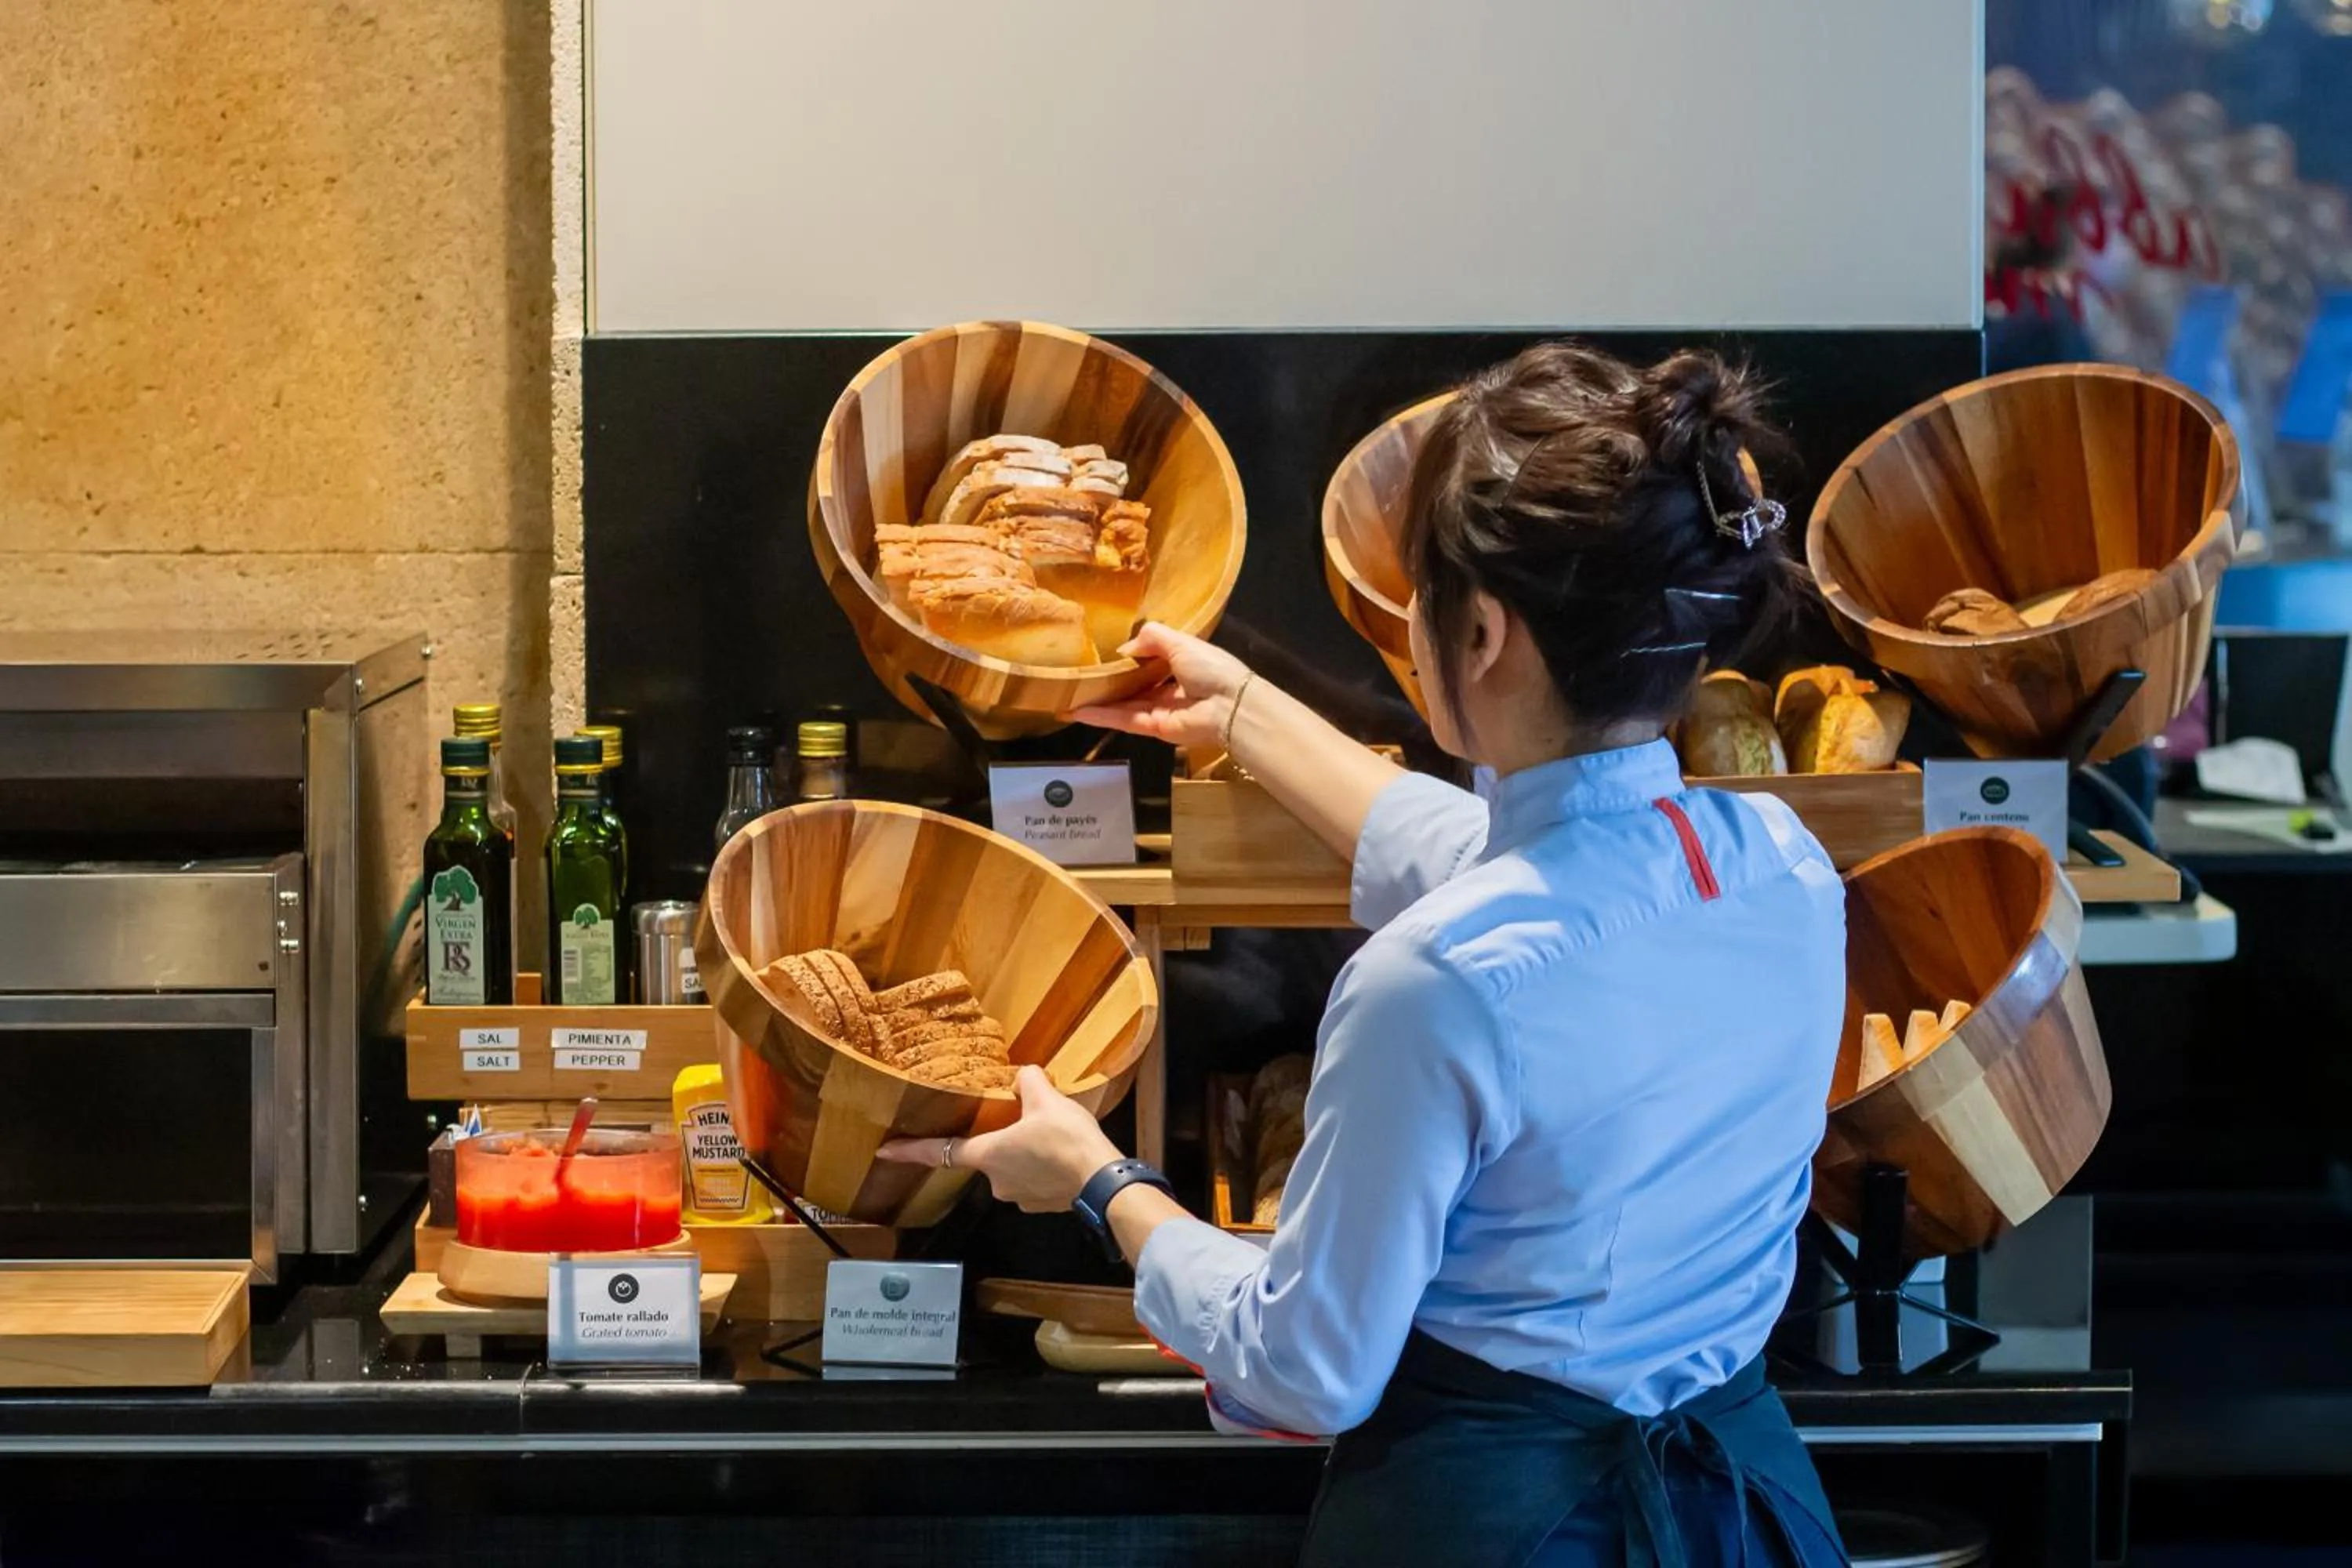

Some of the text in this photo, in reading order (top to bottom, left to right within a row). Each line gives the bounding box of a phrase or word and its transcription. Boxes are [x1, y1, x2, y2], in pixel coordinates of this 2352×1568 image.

[1024, 815, 1046, 826] Pan
[1048, 814, 1062, 826] de
[477, 1033, 503, 1044] SAL
[568, 1033, 632, 1045] PIMIENTA
[477, 1056, 510, 1067] SALT
[572, 1054, 626, 1066] PEPPER
[697, 1112, 732, 1127] HEIN
[697, 1134, 739, 1145] YELLOW
[692, 1147, 746, 1159] MUSTARD
[579, 1310, 669, 1323] Tomate rallado
[830, 1307, 956, 1323] Pan de molde integral
[582, 1326, 668, 1338] Grated tomato
